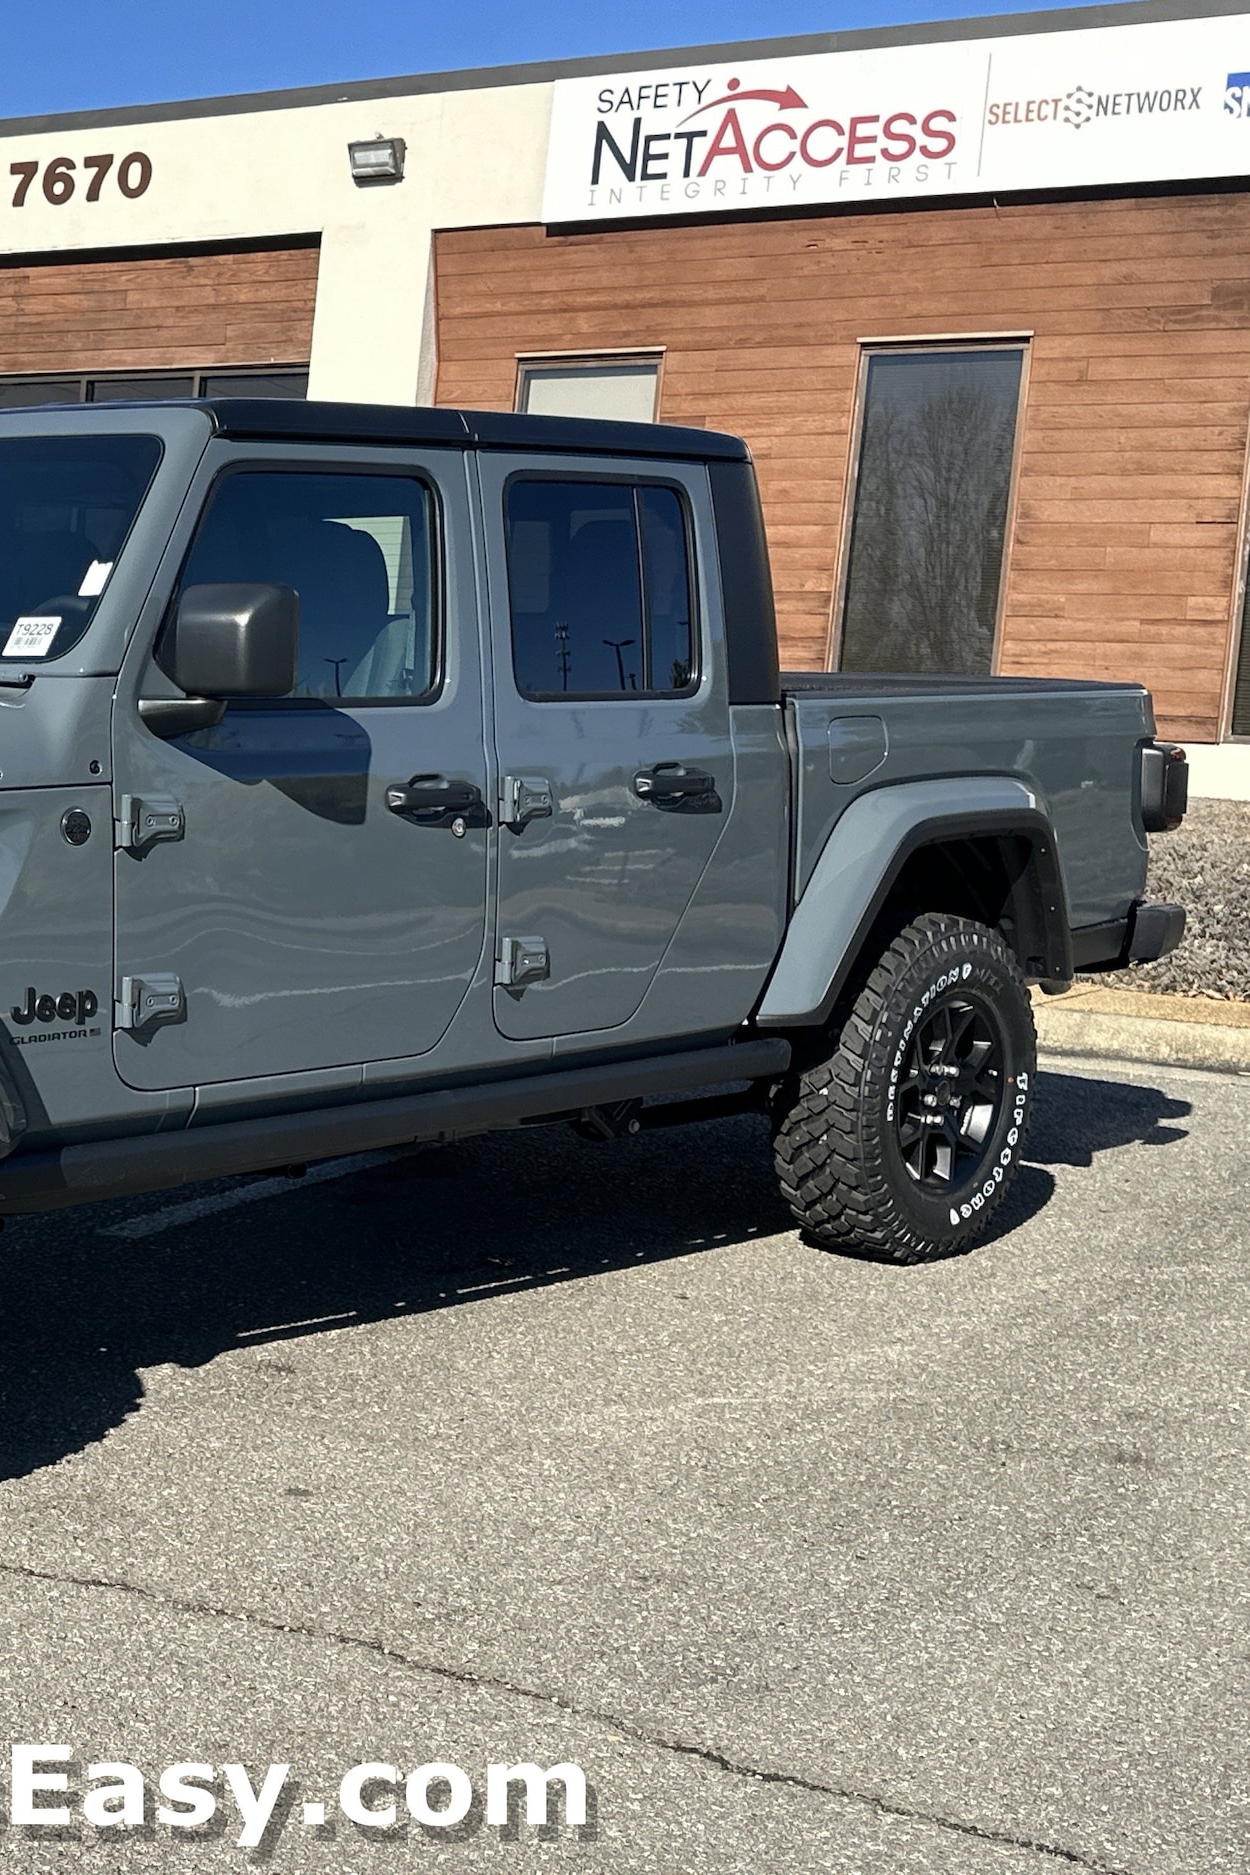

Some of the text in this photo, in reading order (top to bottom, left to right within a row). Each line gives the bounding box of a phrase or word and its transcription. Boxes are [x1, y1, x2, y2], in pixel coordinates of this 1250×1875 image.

[597, 79, 711, 113] SAFETY
[988, 87, 1202, 125] SELECT NETWORX
[10, 151, 153, 208] 7670
[587, 162, 958, 206] INTEGRITY FIRST
[16, 623, 54, 636] T9228
[10, 986, 98, 1025] Jeep
[10, 1028, 88, 1045] GLADIATOR
